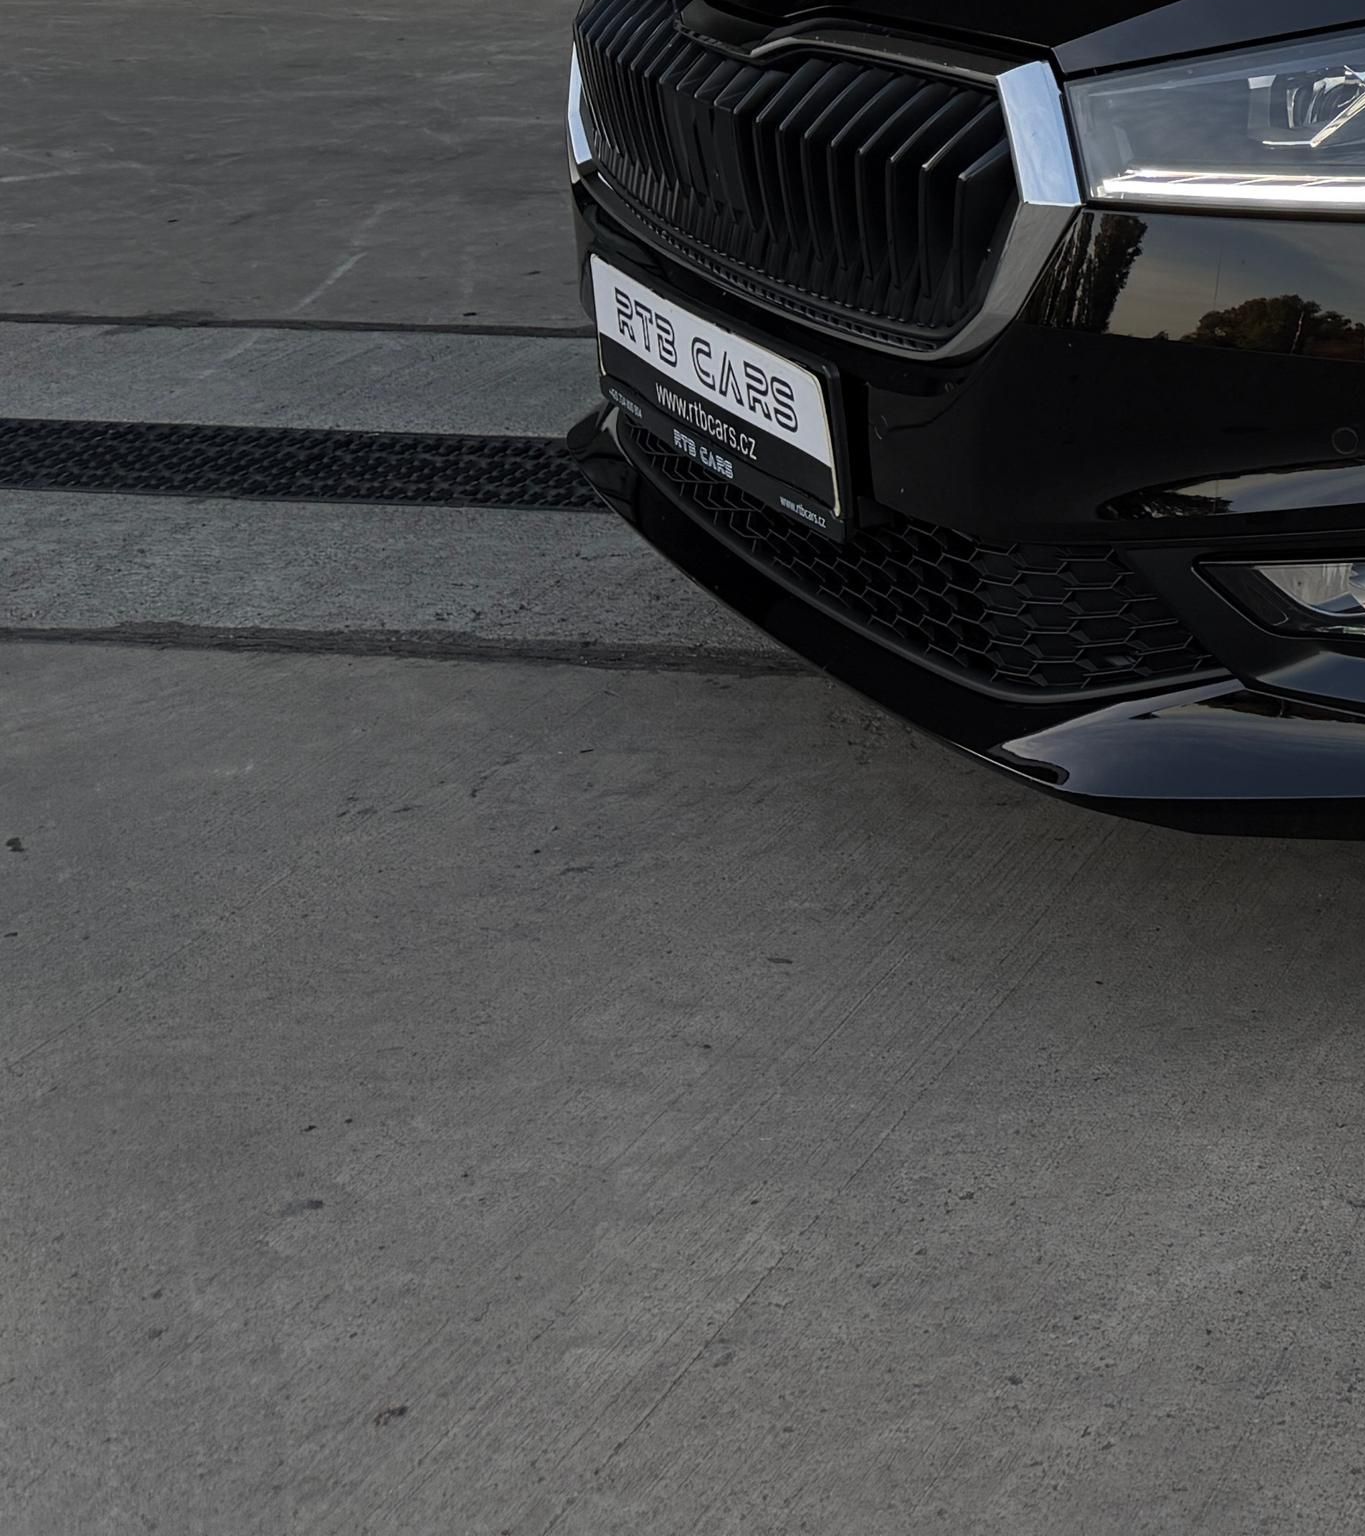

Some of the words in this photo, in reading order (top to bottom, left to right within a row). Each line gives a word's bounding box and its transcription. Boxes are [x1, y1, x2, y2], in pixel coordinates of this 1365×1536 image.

[615, 287, 677, 368] RTB
[691, 336, 798, 433] CARS
[655, 382, 757, 461] www.rtbcars.cz
[673, 428, 697, 458] RTB
[700, 446, 734, 480] CARS
